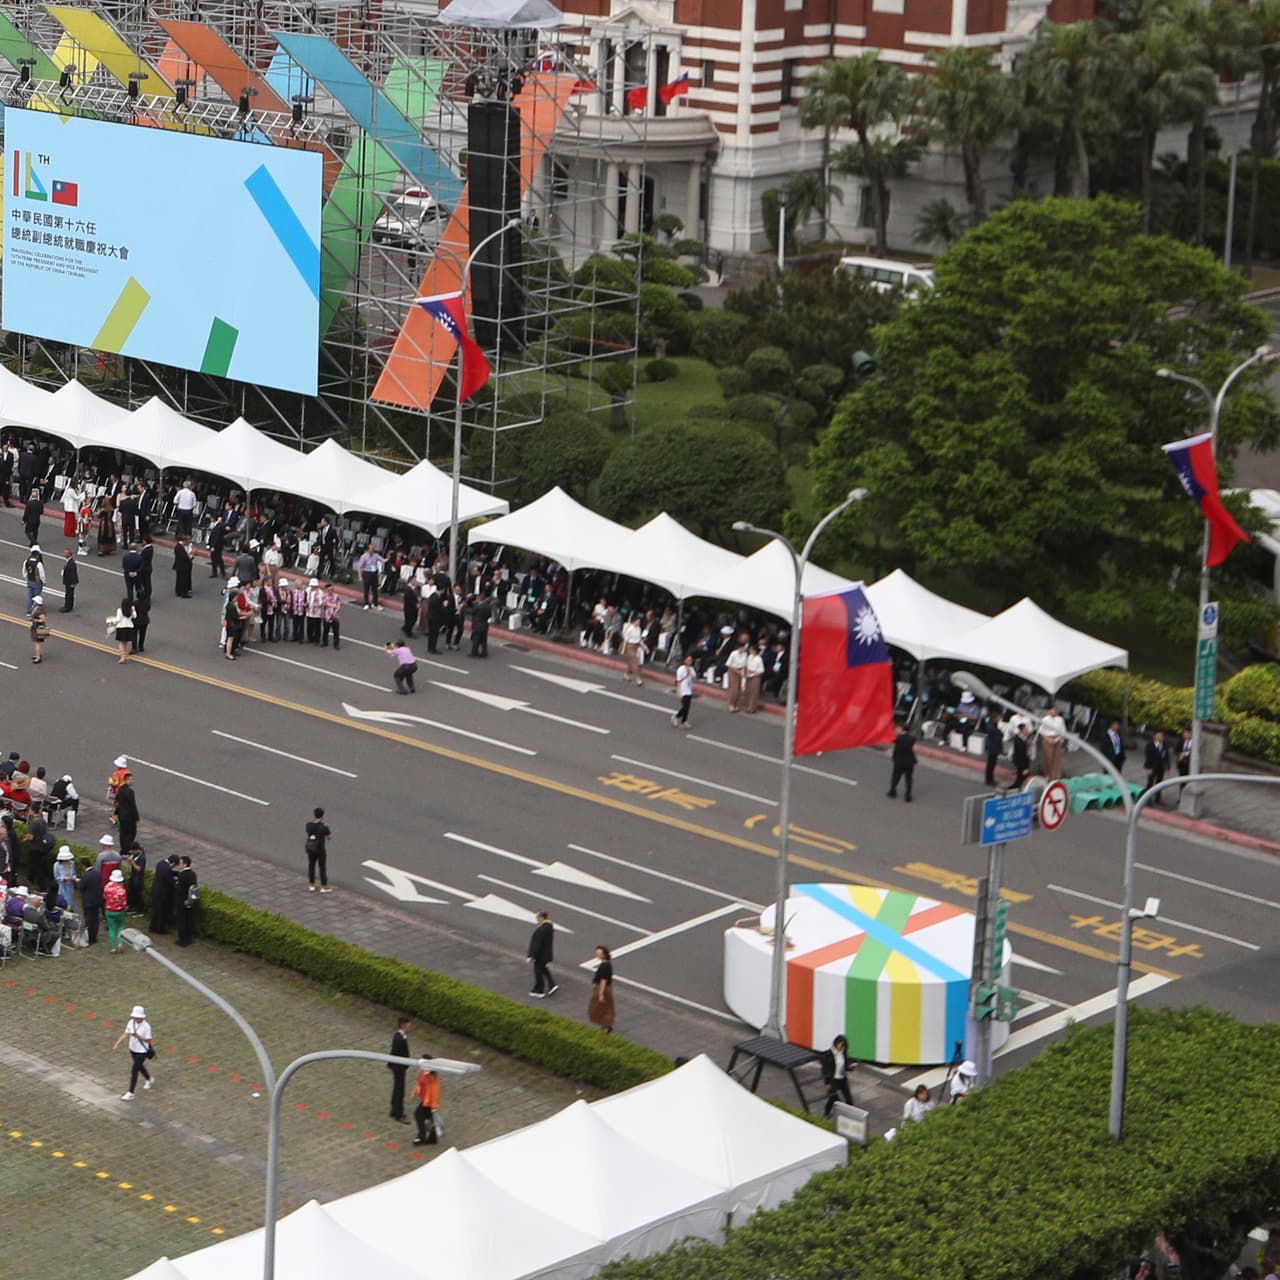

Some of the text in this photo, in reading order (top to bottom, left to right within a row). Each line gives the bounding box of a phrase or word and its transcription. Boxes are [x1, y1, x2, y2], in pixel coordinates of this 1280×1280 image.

[11, 208, 97, 236] 中華民國第十六任
[11, 227, 129, 260] 總統副總統就職慶祝大會
